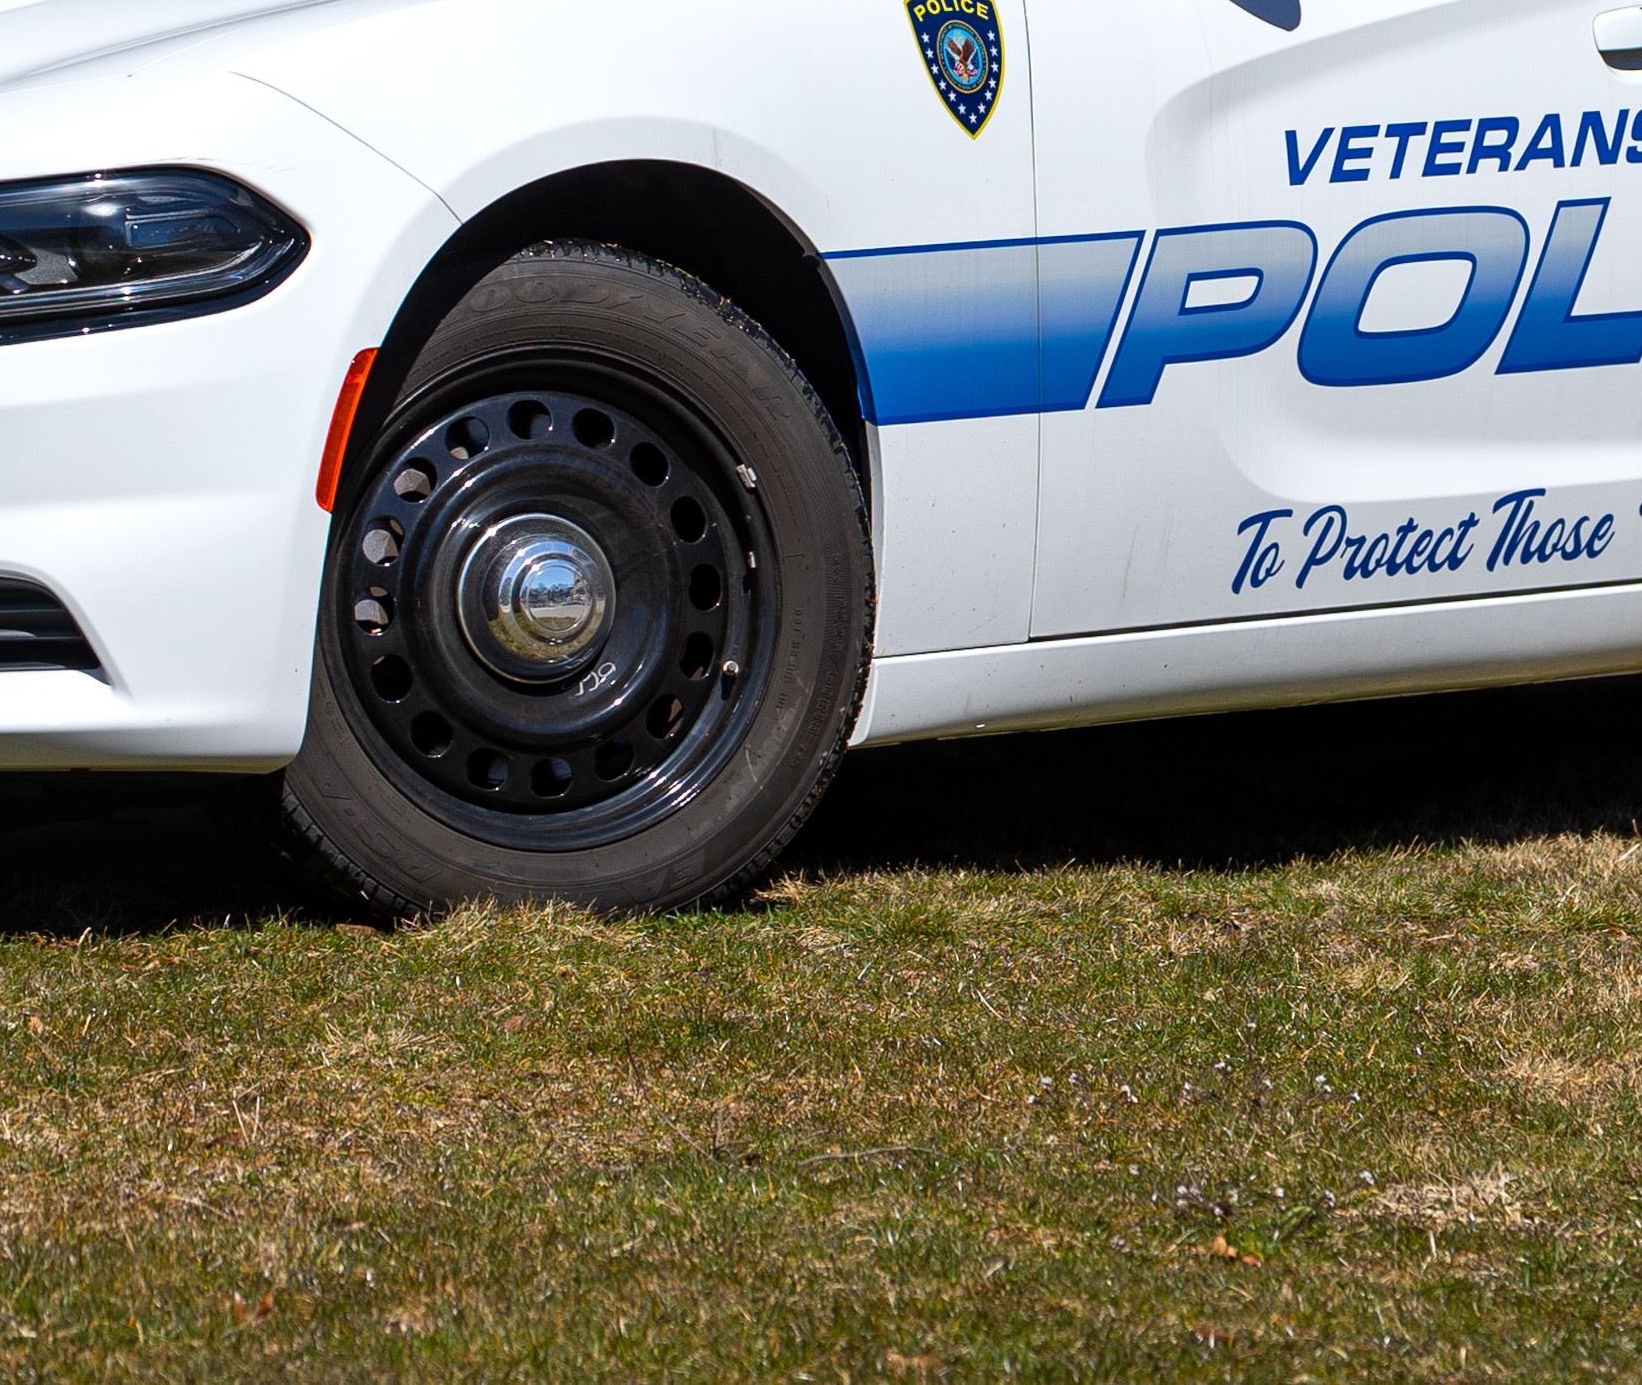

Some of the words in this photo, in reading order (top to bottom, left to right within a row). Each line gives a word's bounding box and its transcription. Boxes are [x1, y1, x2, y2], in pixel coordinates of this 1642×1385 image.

[1231, 508, 1293, 595] To
[1296, 504, 1480, 590] Protect
[1486, 487, 1615, 571] Those
